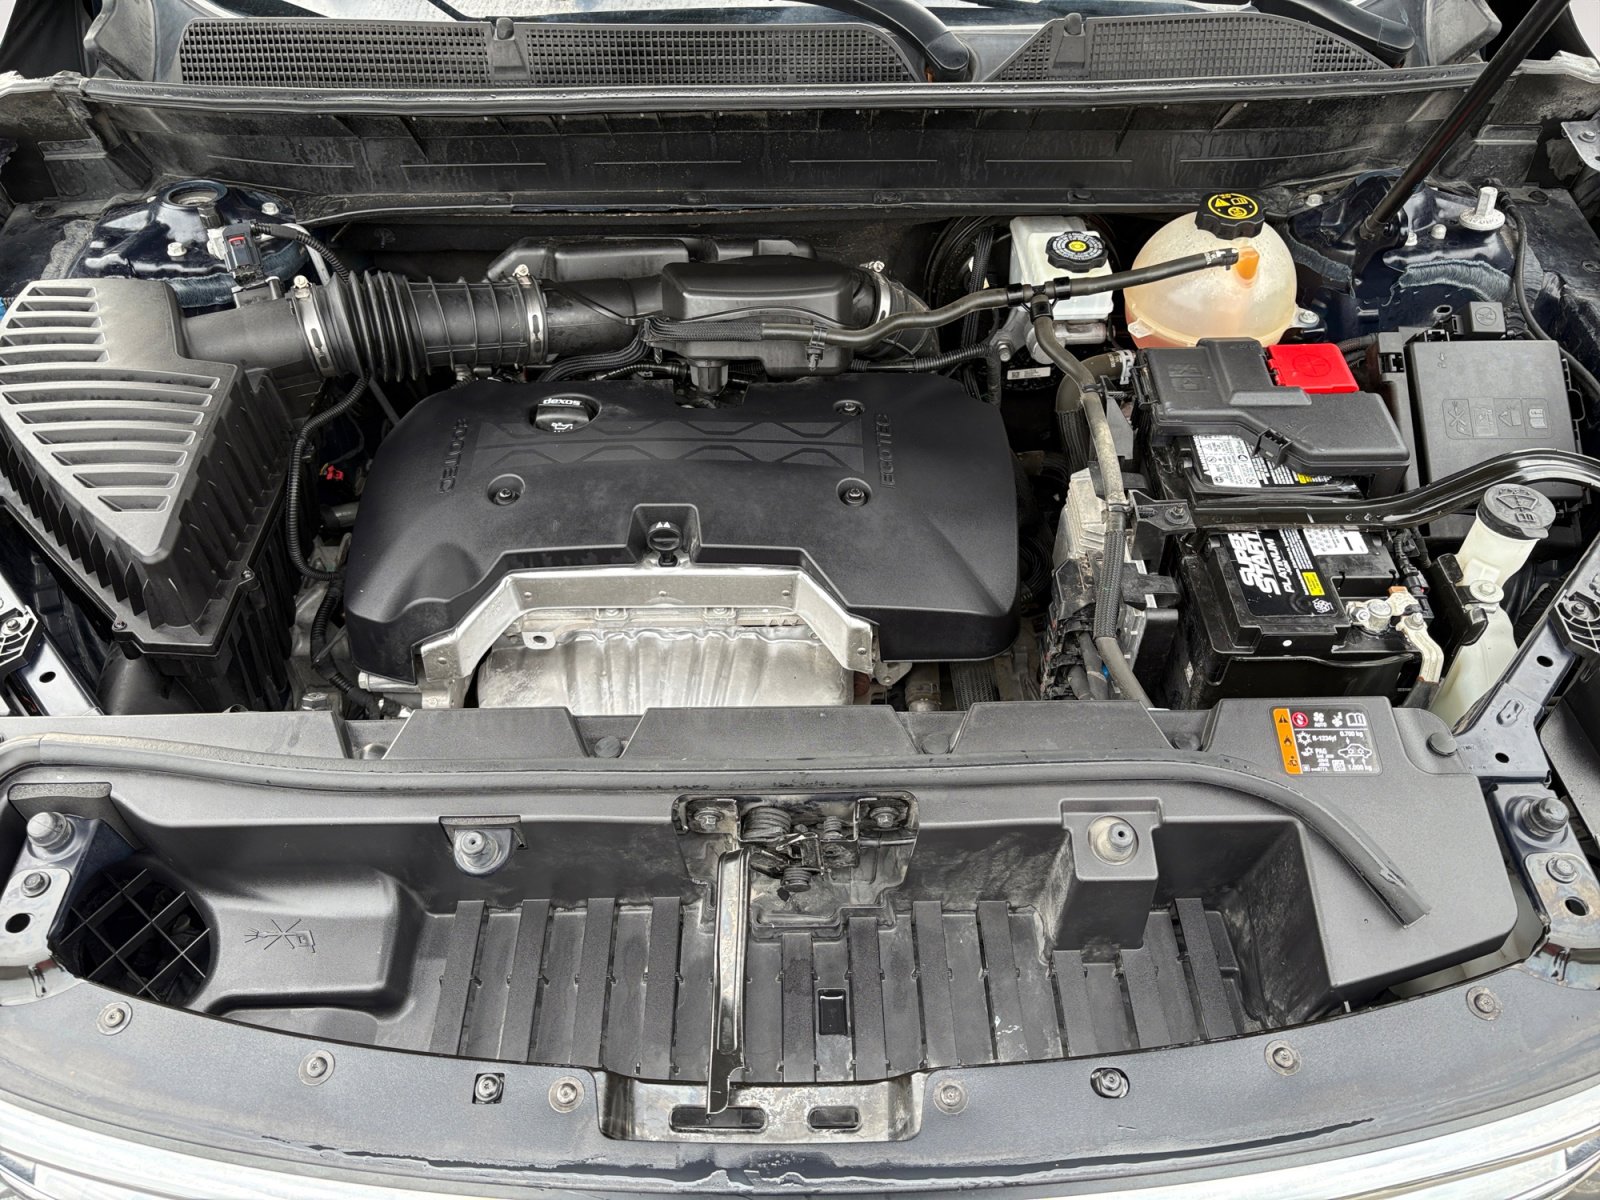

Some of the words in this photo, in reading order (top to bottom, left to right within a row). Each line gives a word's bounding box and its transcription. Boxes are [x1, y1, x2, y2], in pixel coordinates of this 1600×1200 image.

[543, 397, 581, 406] dexos
[439, 418, 468, 494] ECOTEC
[875, 413, 896, 489] ECOTEC
[1266, 538, 1295, 594] PLATINUM
